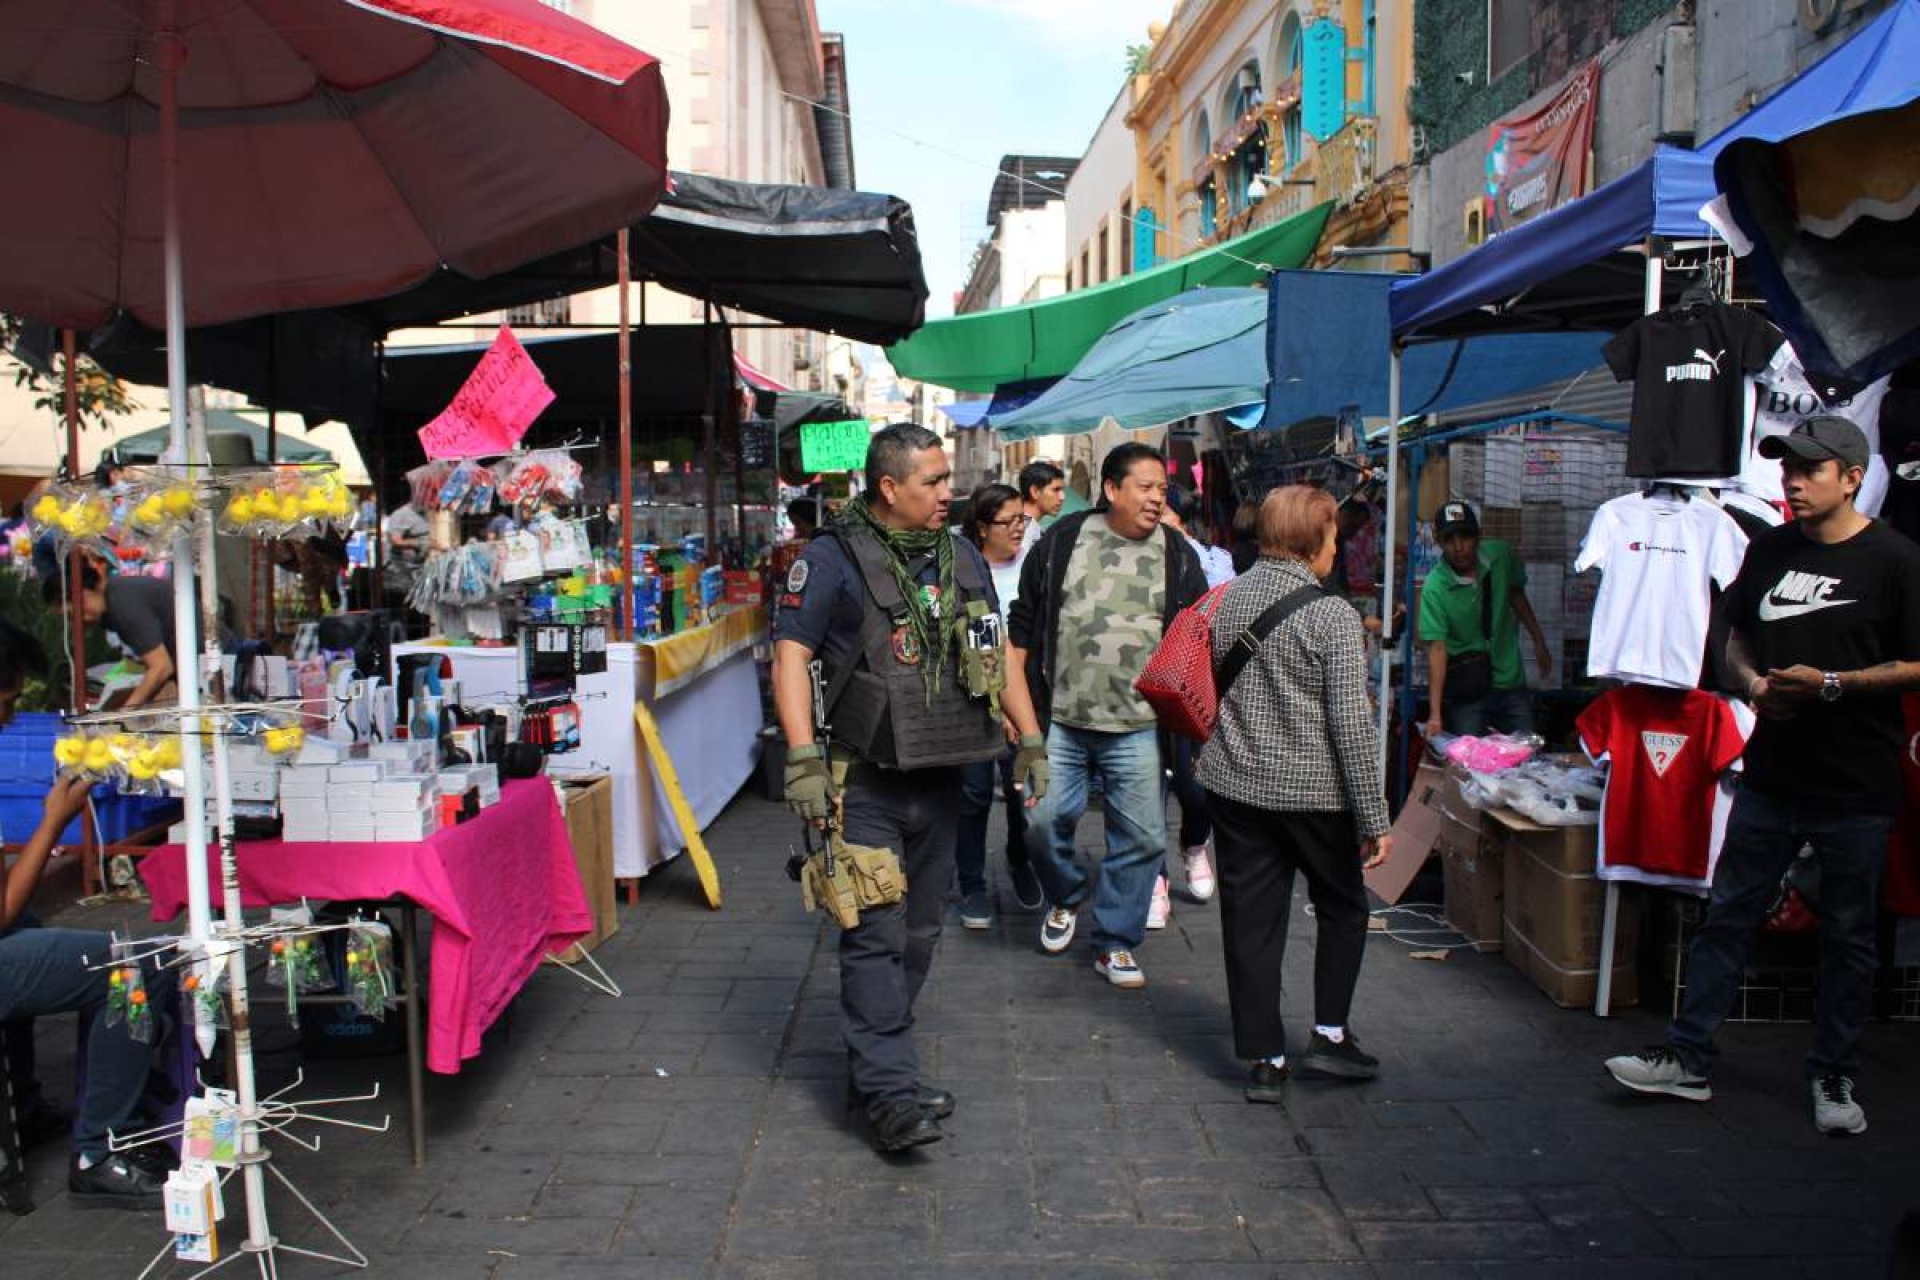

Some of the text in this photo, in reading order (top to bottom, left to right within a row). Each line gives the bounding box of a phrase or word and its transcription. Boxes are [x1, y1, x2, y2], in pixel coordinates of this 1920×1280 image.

[1665, 363, 1711, 382] PUMA
[1766, 391, 1850, 415] BO
[1772, 570, 1842, 603] NIKE
[1643, 735, 1682, 747] GUESS
